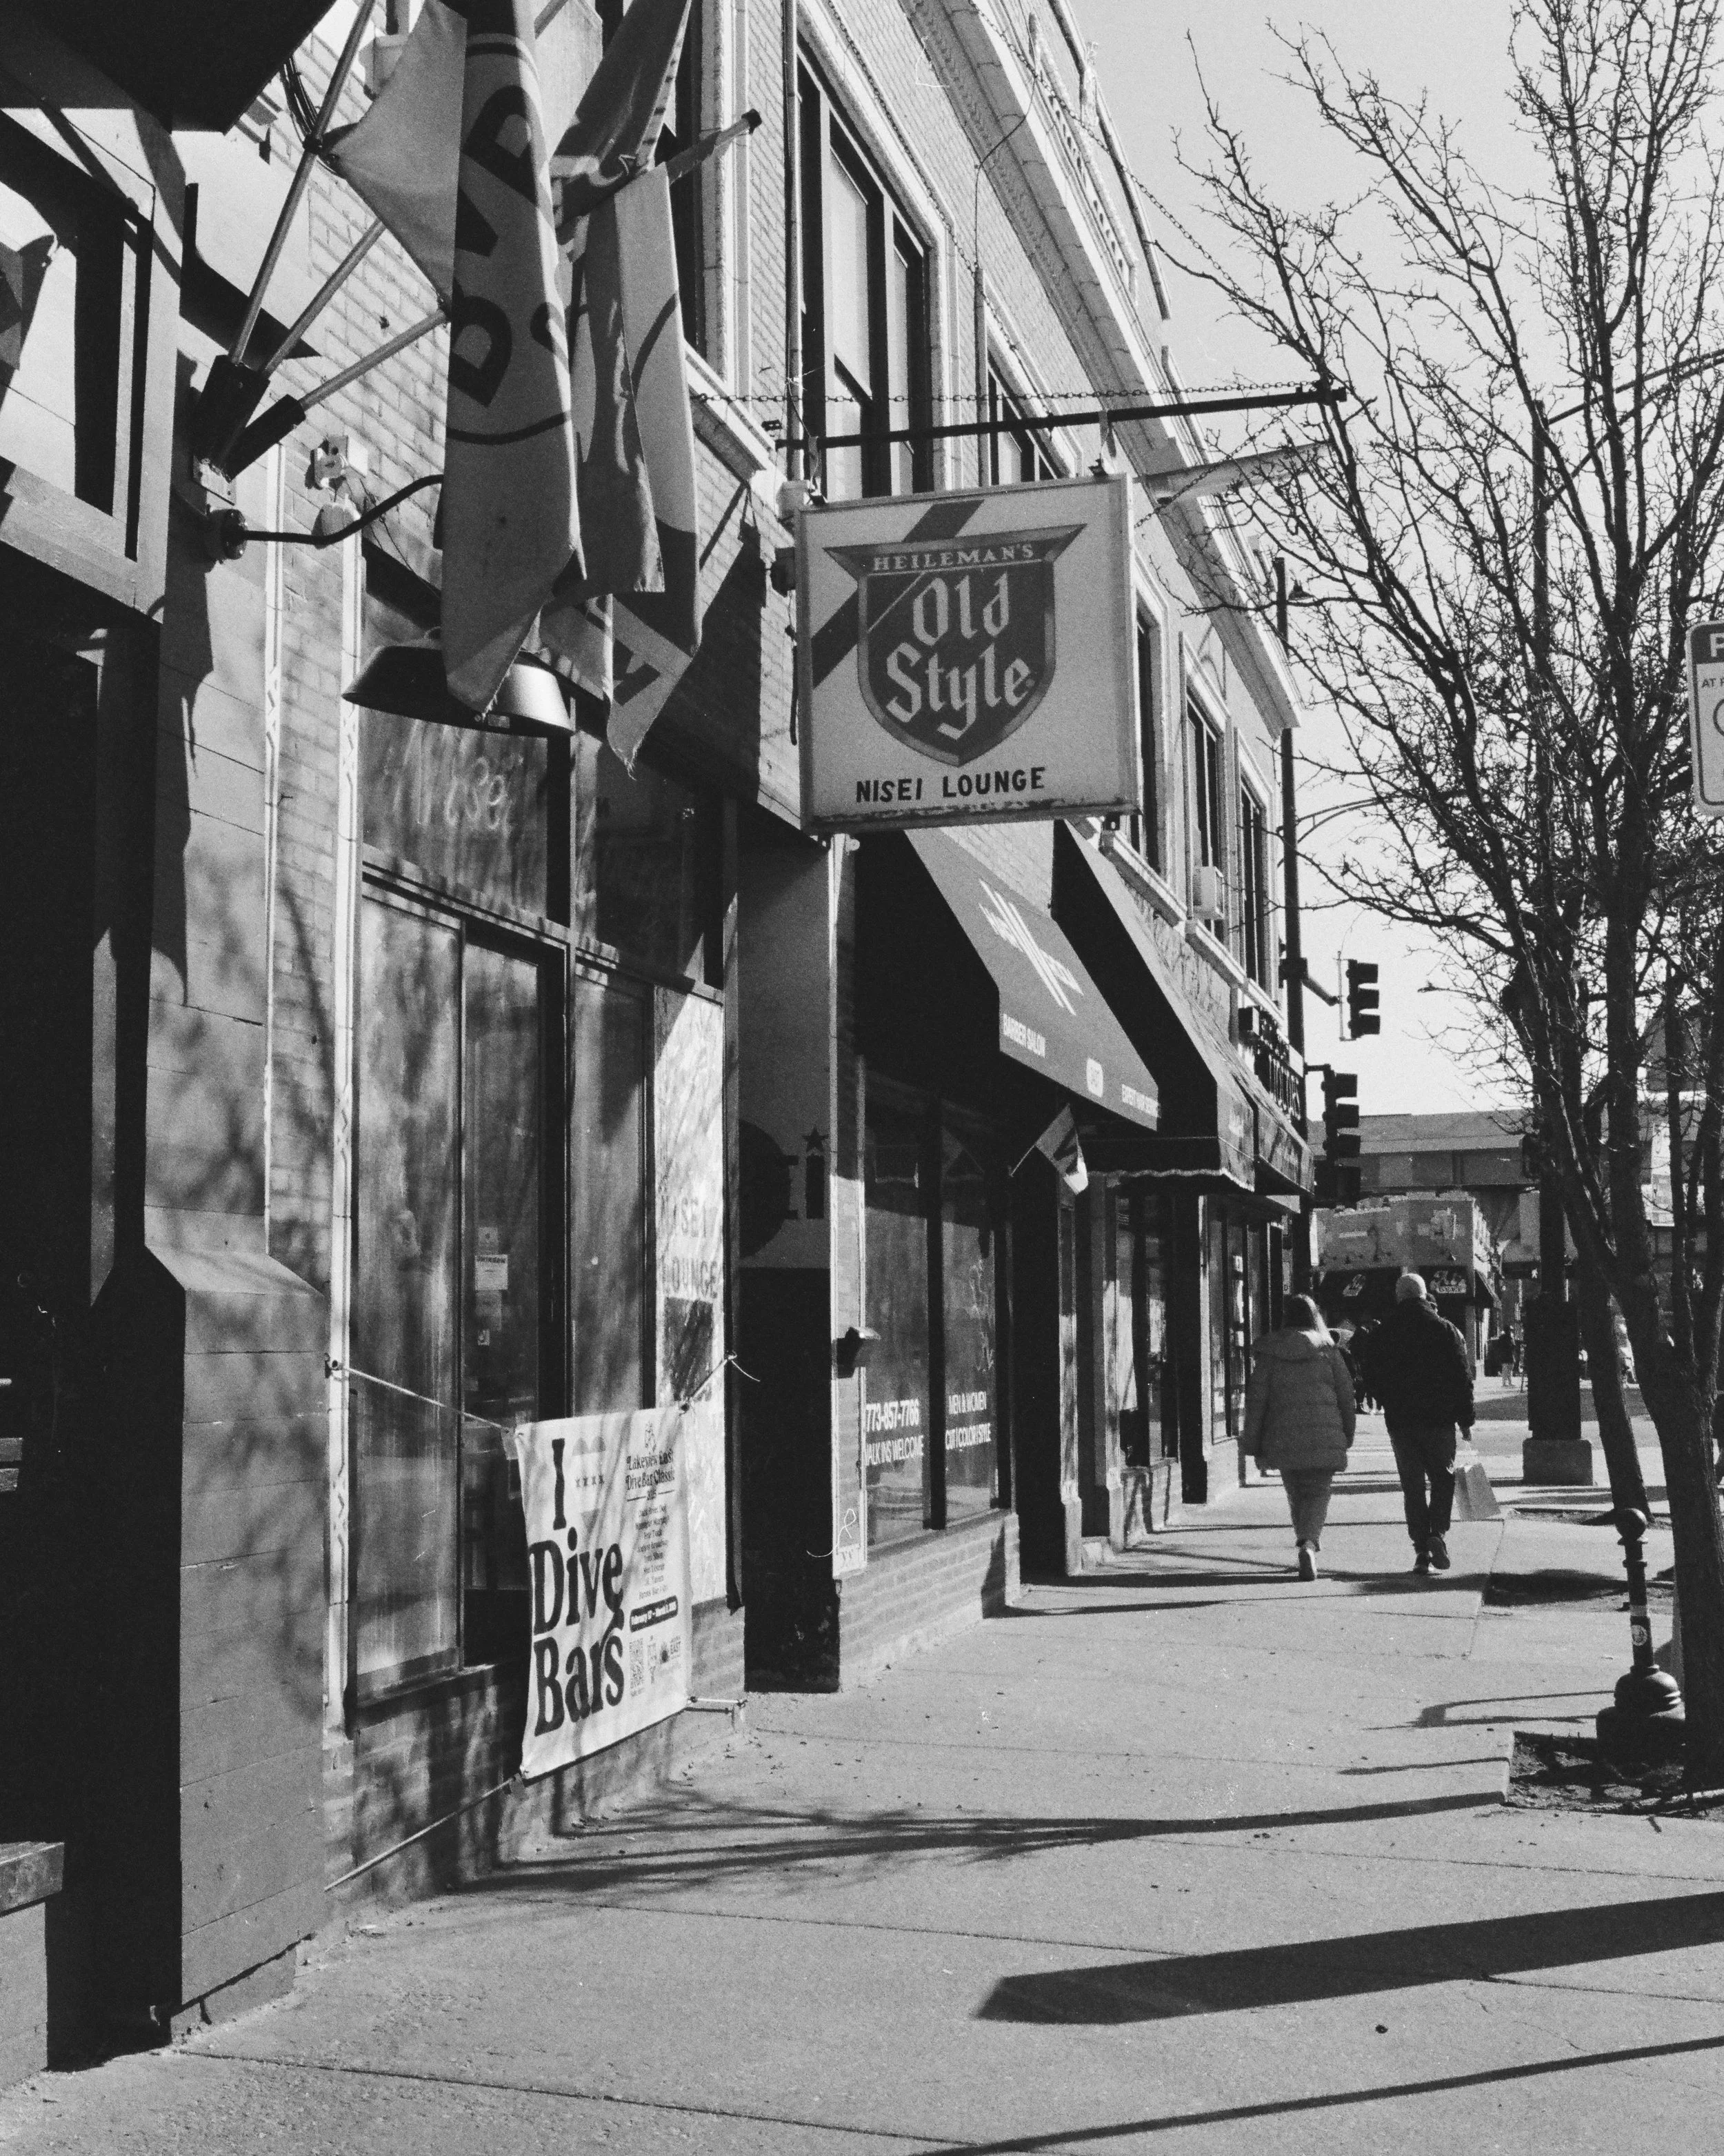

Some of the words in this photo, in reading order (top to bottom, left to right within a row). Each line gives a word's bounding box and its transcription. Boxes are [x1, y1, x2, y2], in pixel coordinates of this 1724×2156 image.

[872, 543, 1035, 572] HEILEMAN'S
[912, 572, 1011, 646] Old
[886, 643, 1033, 741] Style
[1701, 678, 1716, 688] AT
[856, 777, 923, 803] NISEI
[942, 766, 1047, 799] LOUNGE
[865, 1399, 920, 1433] 773-857-7766
[966, 1391, 987, 1413] WOMEN
[892, 1435, 924, 1461] WELCOME
[551, 1438, 567, 1531] I
[625, 1474, 641, 1490] Dive
[528, 1527, 624, 1638] Dive
[533, 1621, 625, 1737] Bars
